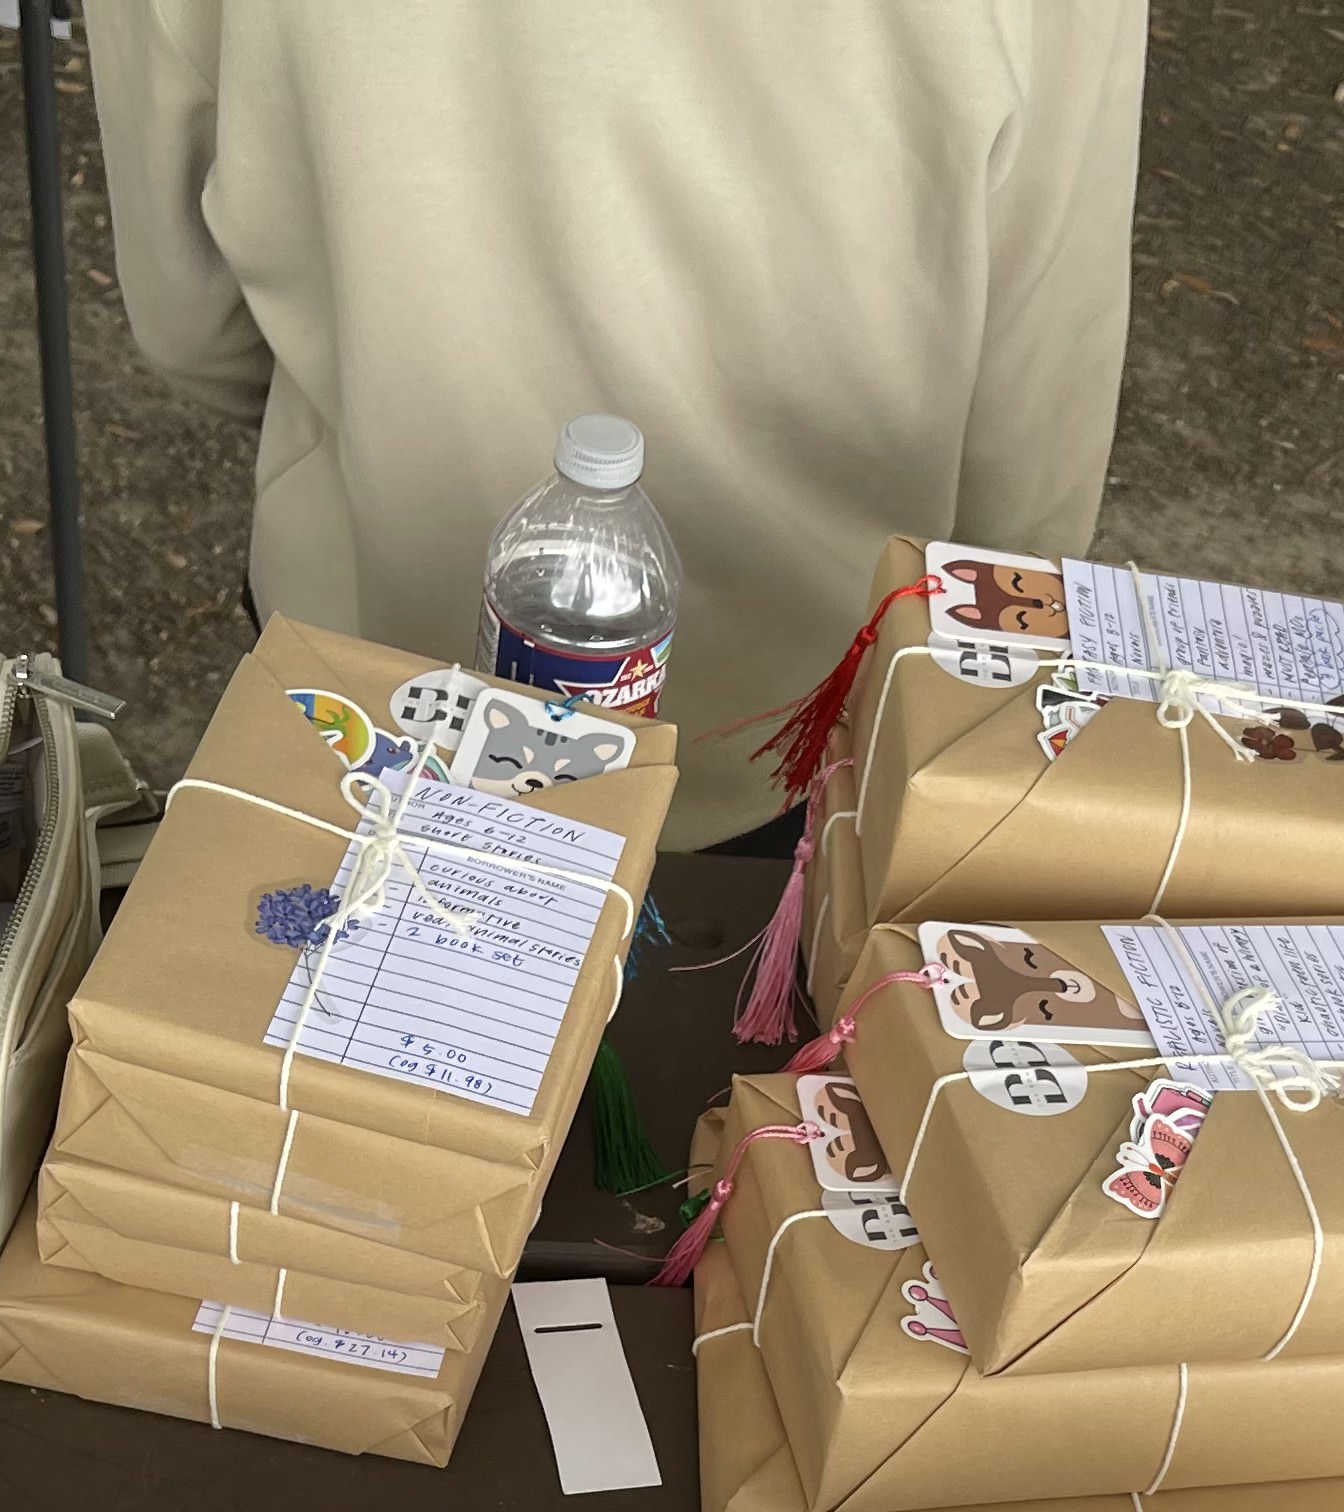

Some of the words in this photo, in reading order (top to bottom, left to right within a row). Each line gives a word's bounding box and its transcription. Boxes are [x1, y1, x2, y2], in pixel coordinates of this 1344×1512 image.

[415, 787, 585, 843] NON-FICTION
[432, 812, 470, 827] Ages
[484, 826, 527, 844] 6-12
[482, 842, 541, 865] stories
[428, 877, 503, 907] animals
[430, 864, 494, 887] curious
[504, 884, 558, 906] about
[537, 876, 567, 891] NAME
[407, 927, 421, 937] 2
[435, 934, 484, 954] book
[492, 950, 525, 967] set
[529, 944, 581, 967] stories
[1119, 933, 1158, 988] FICTION
